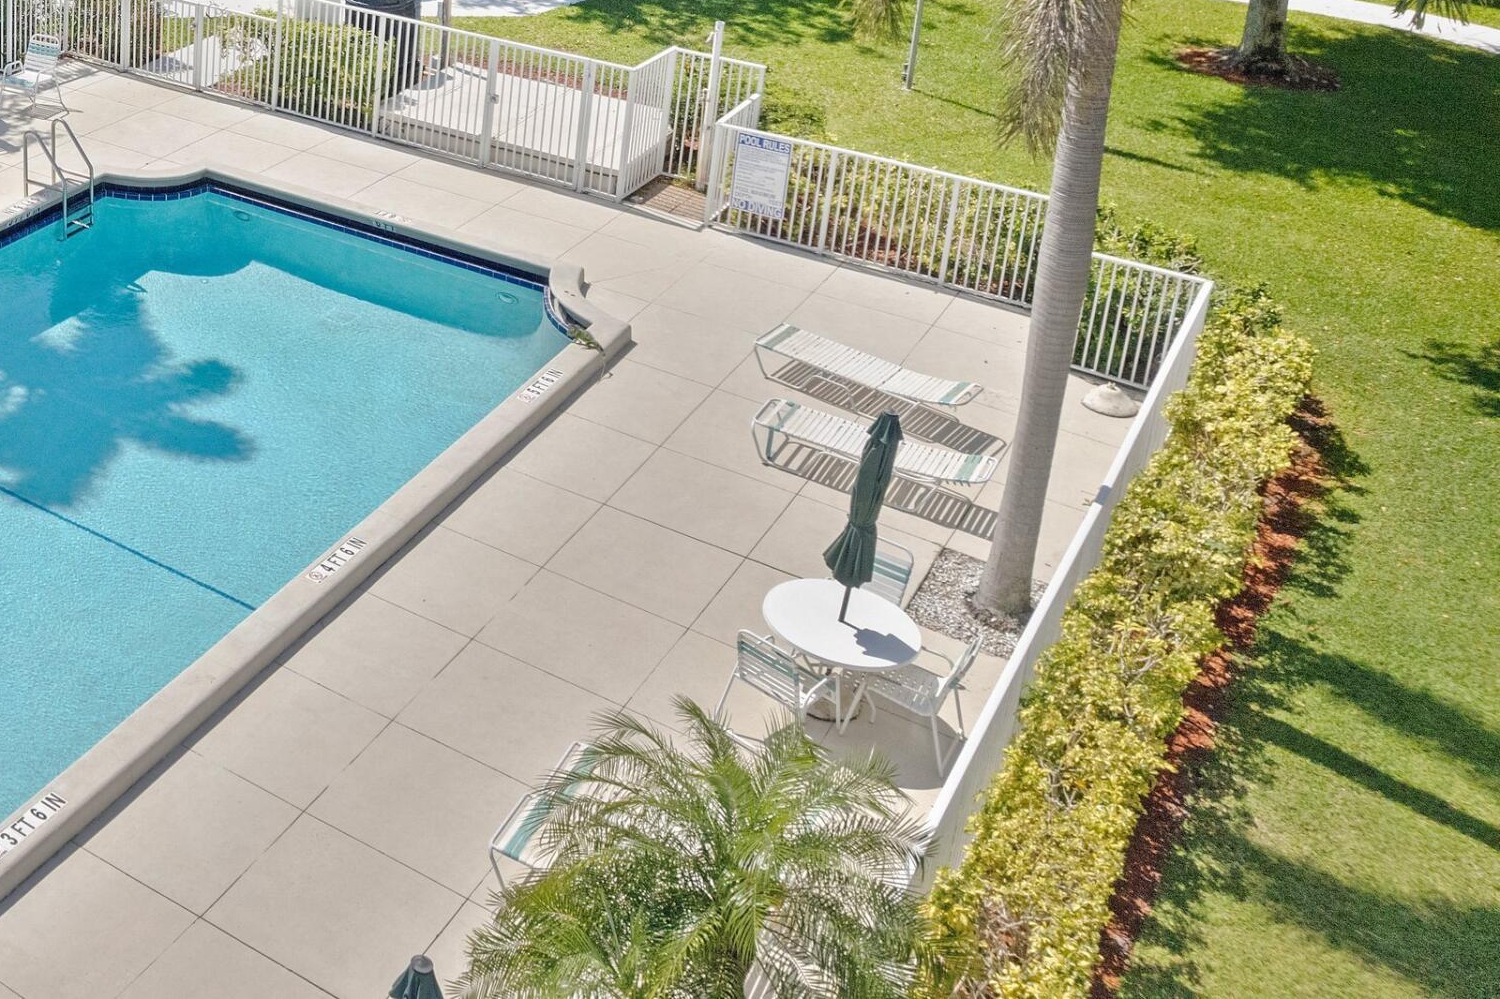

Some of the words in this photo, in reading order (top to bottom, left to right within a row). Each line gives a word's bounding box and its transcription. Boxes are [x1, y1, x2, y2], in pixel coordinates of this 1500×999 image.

[740, 133, 762, 148] POOL
[763, 139, 791, 154] RULES
[732, 198, 746, 209] NO
[747, 200, 783, 218] DIVING
[532, 380, 548, 391] FT
[546, 368, 564, 379] IN
[339, 547, 355, 556] 6
[346, 537, 367, 550] IN
[320, 563, 336, 572] 4
[327, 552, 347, 567] FT
[0, 832, 18, 846] 3
[10, 816, 36, 837] FT
[30, 808, 47, 821] 6
[40, 792, 66, 812] IN
